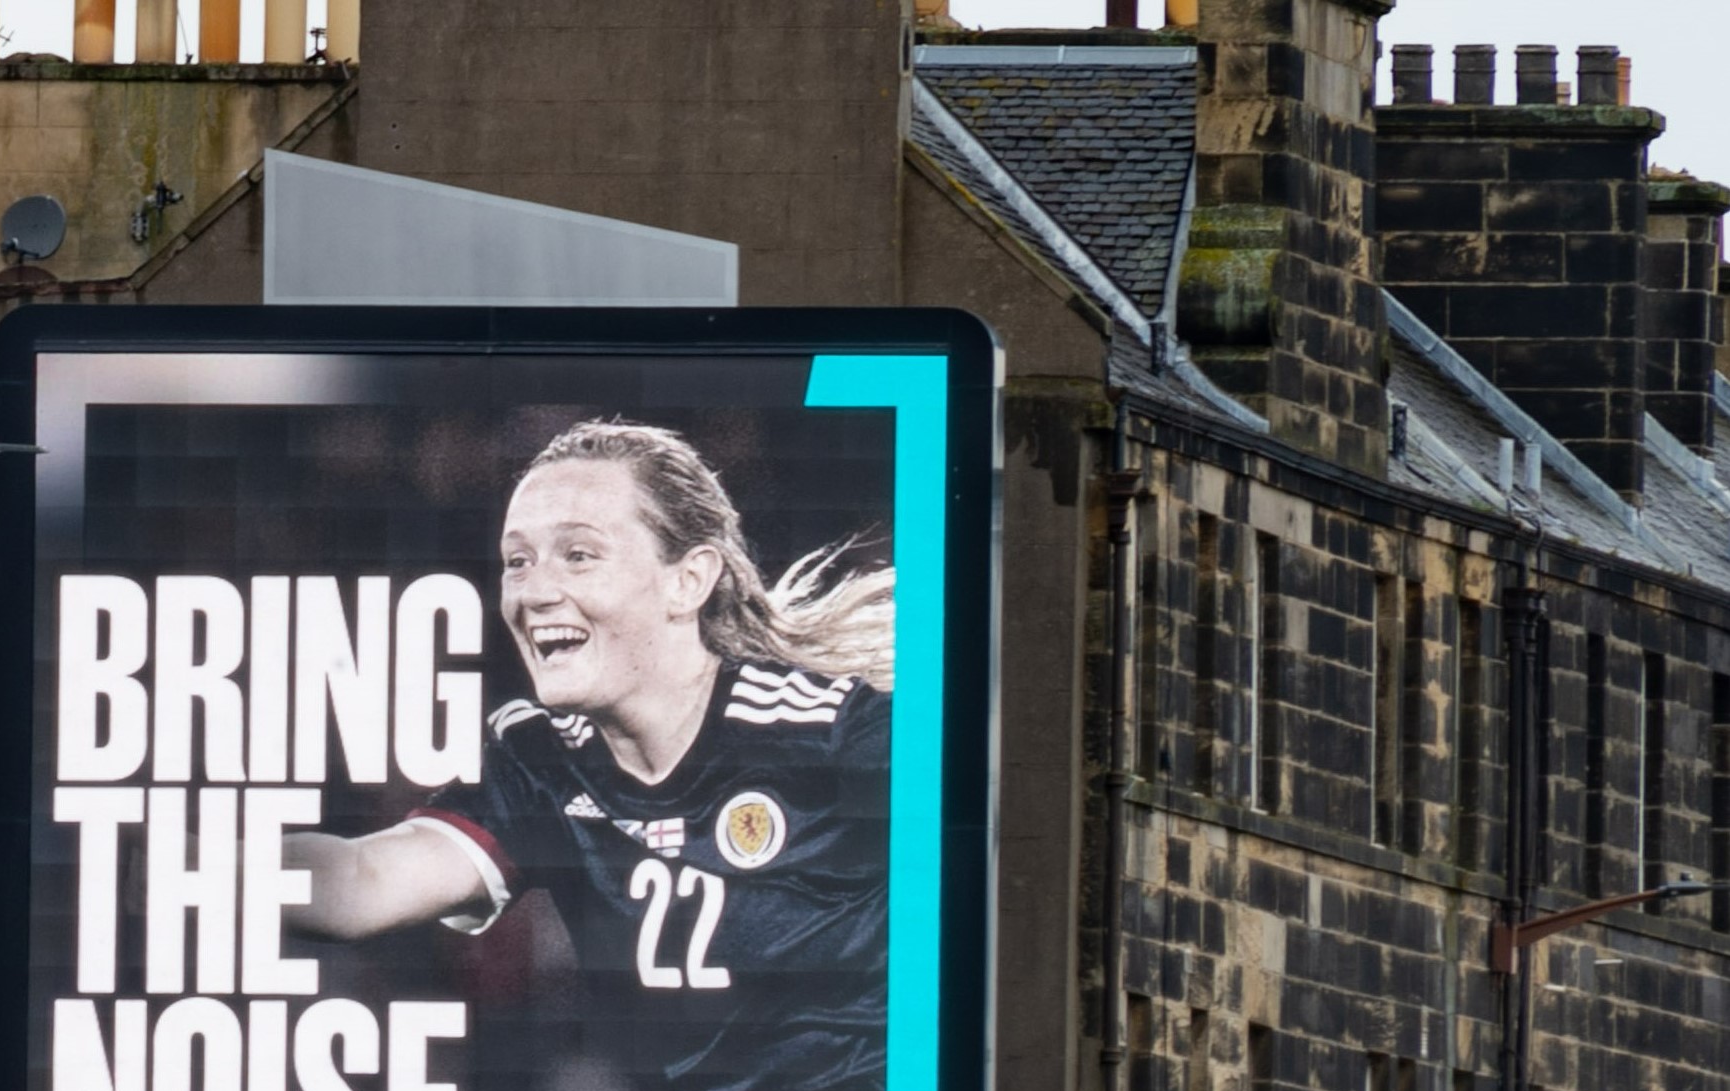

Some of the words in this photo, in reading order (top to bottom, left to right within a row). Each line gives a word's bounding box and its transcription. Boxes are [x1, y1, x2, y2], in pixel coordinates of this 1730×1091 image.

[57, 573, 482, 786] BRING
[53, 787, 322, 995] THE
[629, 858, 731, 989] 22
